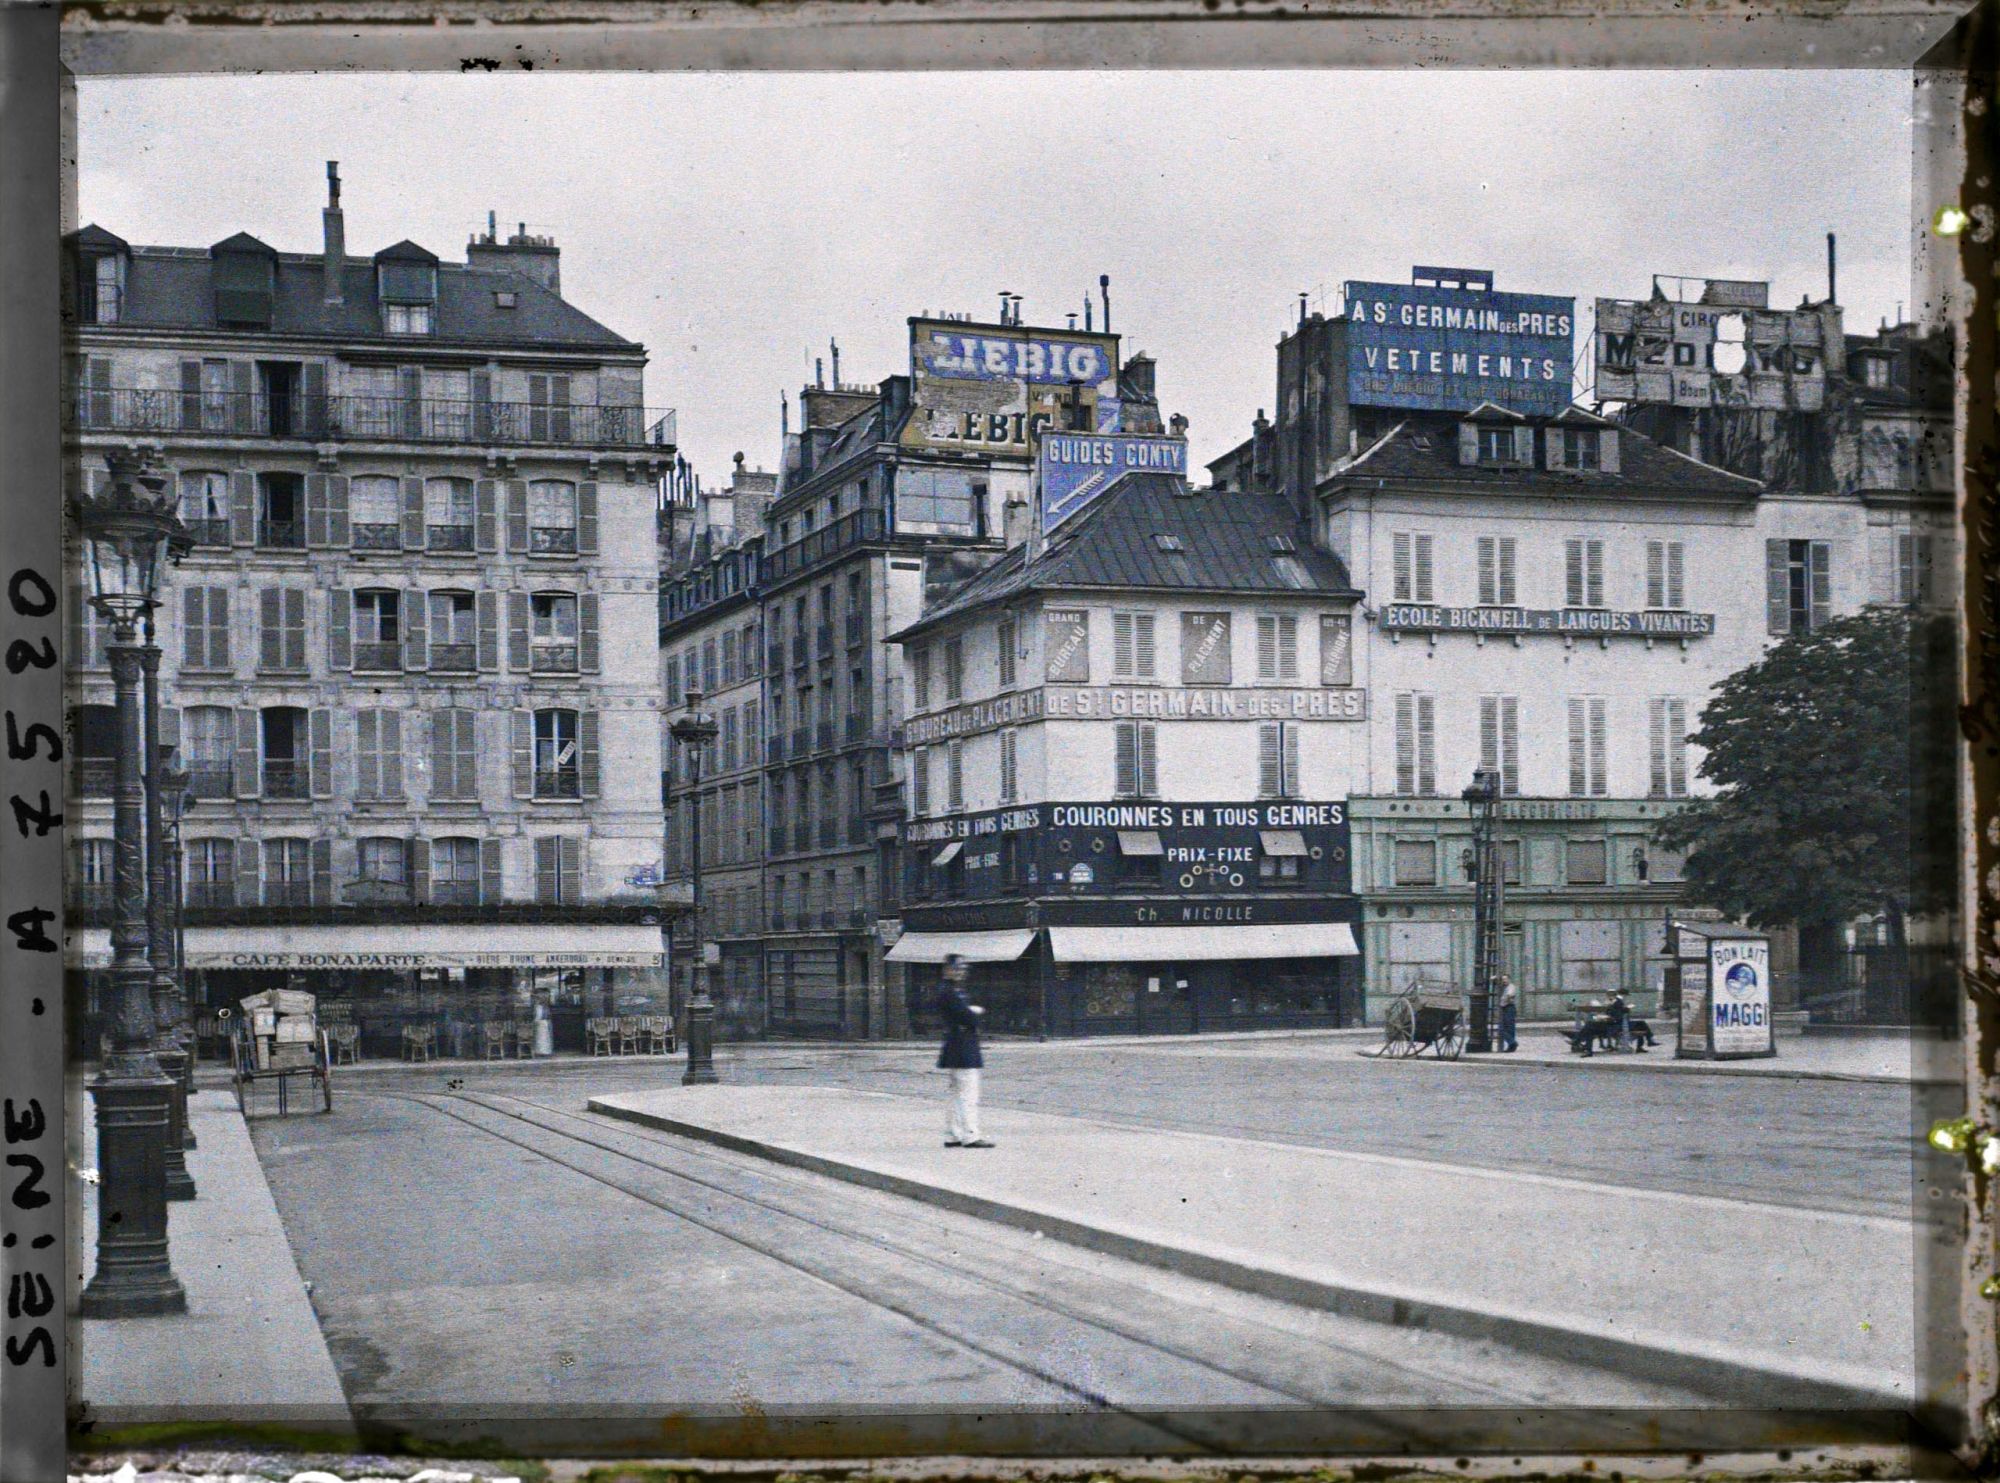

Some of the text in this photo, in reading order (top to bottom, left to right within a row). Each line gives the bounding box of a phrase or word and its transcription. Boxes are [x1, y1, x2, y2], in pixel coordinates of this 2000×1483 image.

[1351, 300, 1366, 322] A
[1401, 304, 1499, 332] GERMAIN
[1518, 312, 1571, 336] PRES
[1365, 347, 1555, 381] VETEMENTS
[1049, 439, 1181, 468] GUIDES CONTY
[1048, 613, 1080, 623] GRAND
[1192, 615, 1206, 625] DE
[1450, 608, 1533, 630] BICKNELL
[1558, 611, 1630, 631] LANGUES
[1637, 613, 1710, 633] VIVANTES
[1049, 626, 1086, 676] BUREAU
[1190, 618, 1227, 673] PLACEMENT
[972, 690, 1042, 729] PLACEMENT
[1047, 696, 1070, 715] DE
[1053, 805, 1343, 827] COURONNES EN TOUS GENRES
[1168, 847, 1253, 863] PRIX-FIXE
[1182, 906, 1254, 921] NICOLLE
[299, 954, 427, 967] BONAPARTE
[1715, 1002, 1769, 1027] MAGGI
